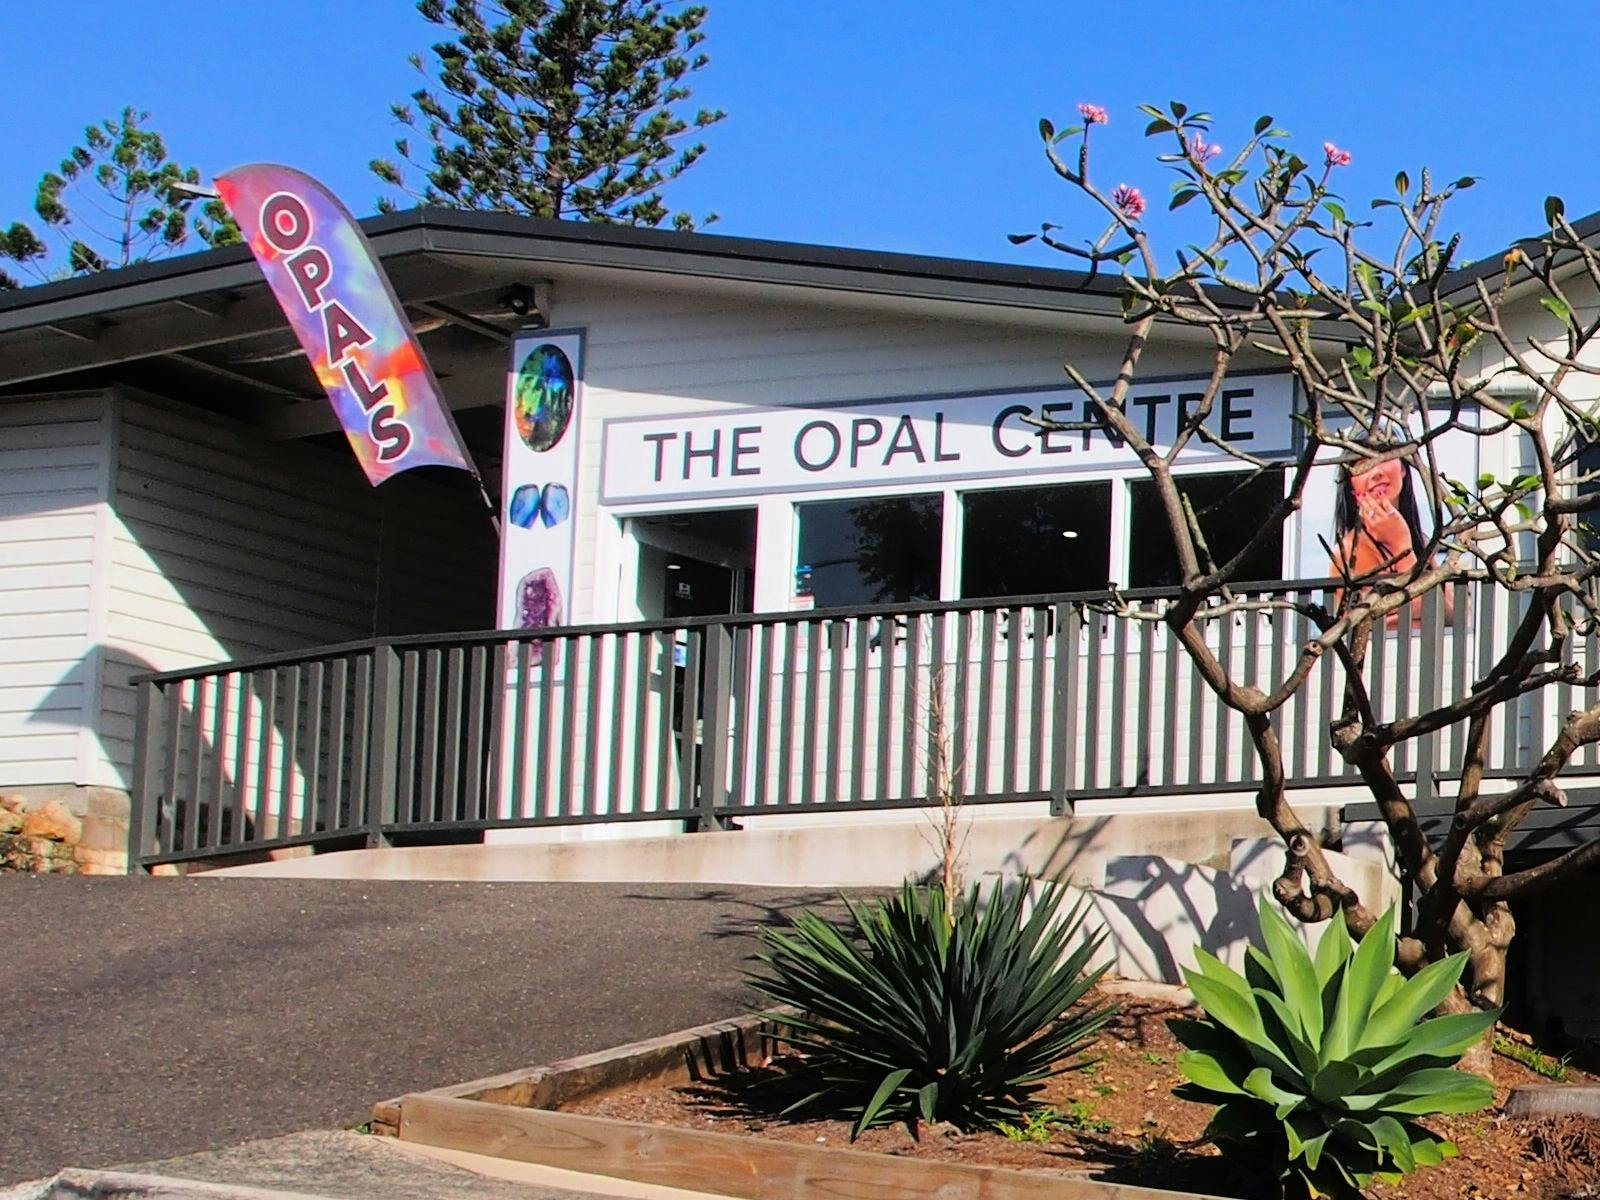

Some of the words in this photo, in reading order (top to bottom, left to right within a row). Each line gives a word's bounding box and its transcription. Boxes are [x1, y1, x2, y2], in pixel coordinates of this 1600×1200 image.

[260, 191, 413, 463] OPALS
[643, 426, 762, 481] THE
[794, 412, 961, 472] OPAL
[992, 388, 1255, 458] CENTRE
